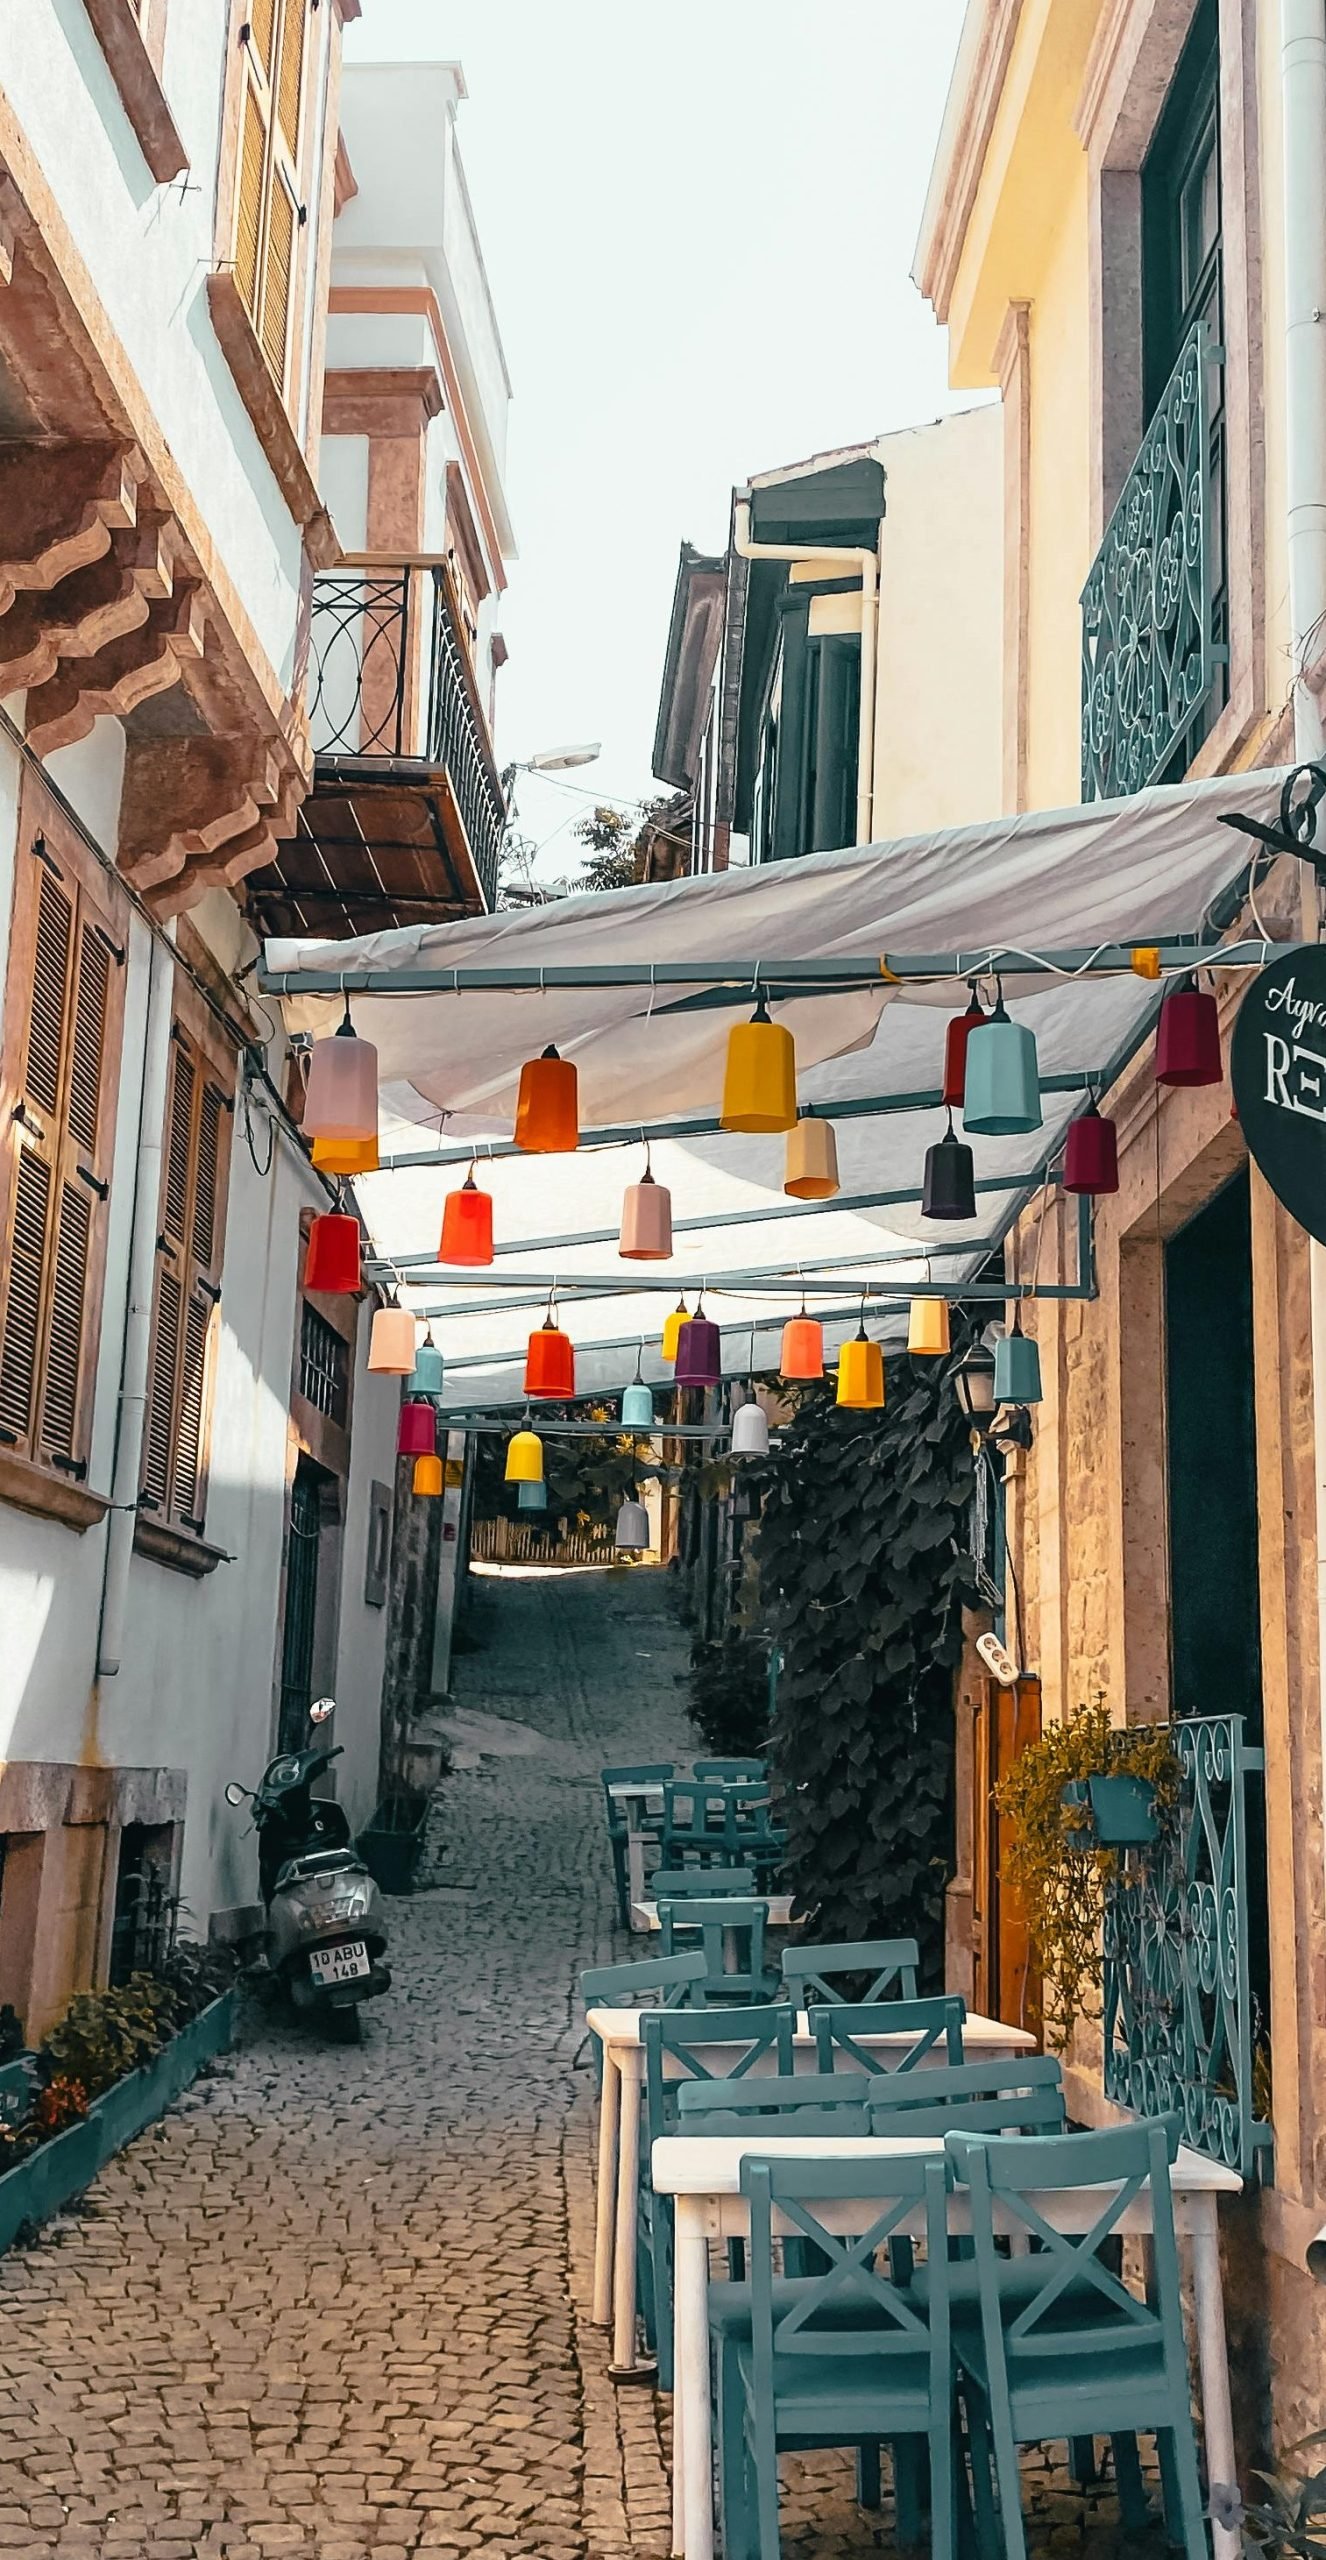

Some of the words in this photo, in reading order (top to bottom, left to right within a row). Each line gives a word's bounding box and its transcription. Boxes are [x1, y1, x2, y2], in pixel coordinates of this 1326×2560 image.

[312, 1951, 330, 1968] 10
[334, 1943, 365, 1963] ABU
[333, 1962, 358, 1980] 148
